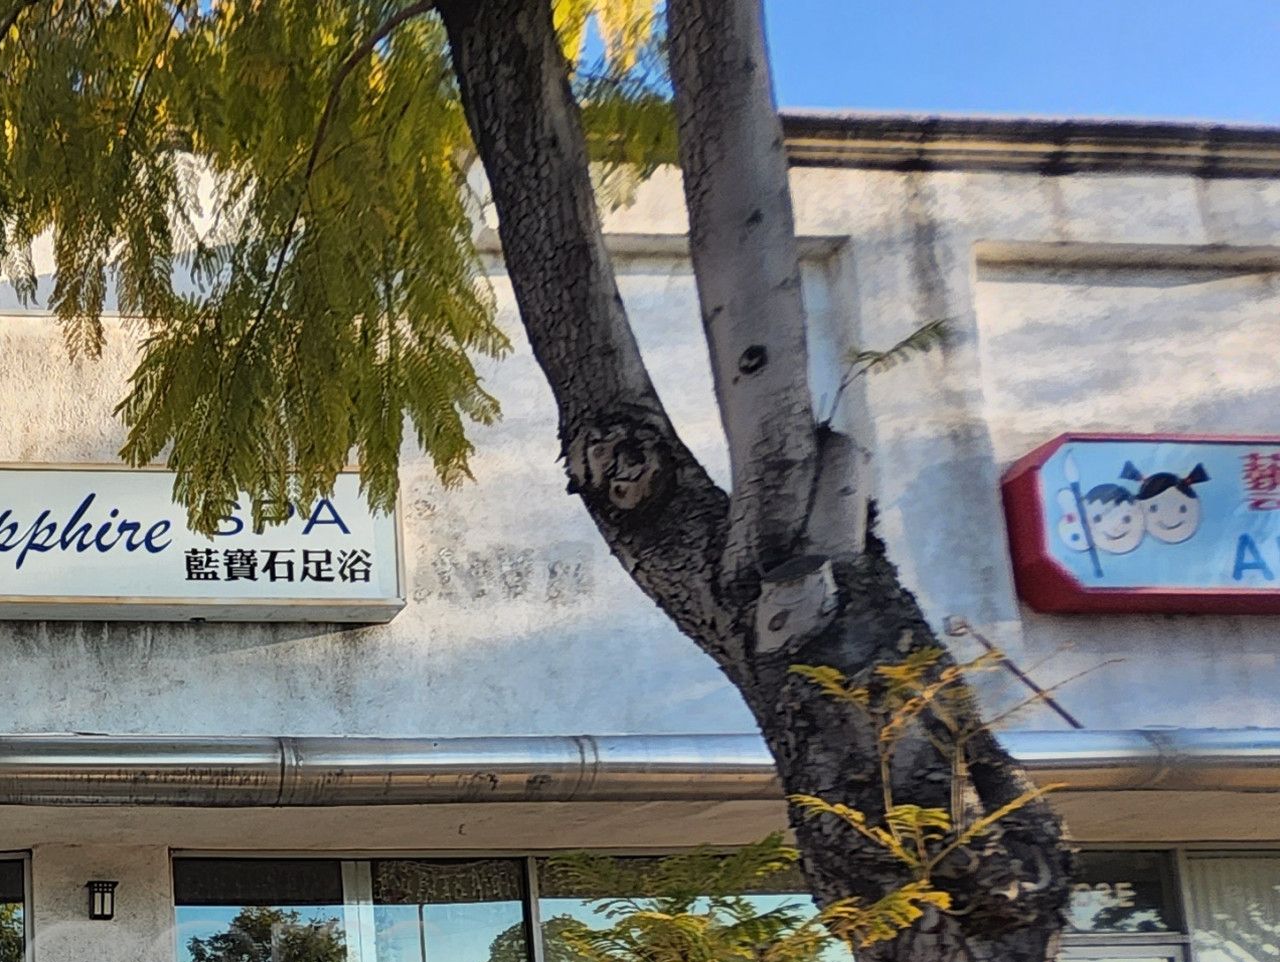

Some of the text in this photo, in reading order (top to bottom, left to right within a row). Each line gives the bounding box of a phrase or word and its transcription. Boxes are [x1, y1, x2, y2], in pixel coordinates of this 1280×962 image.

[184, 548, 373, 583] 藍寶石足浴
